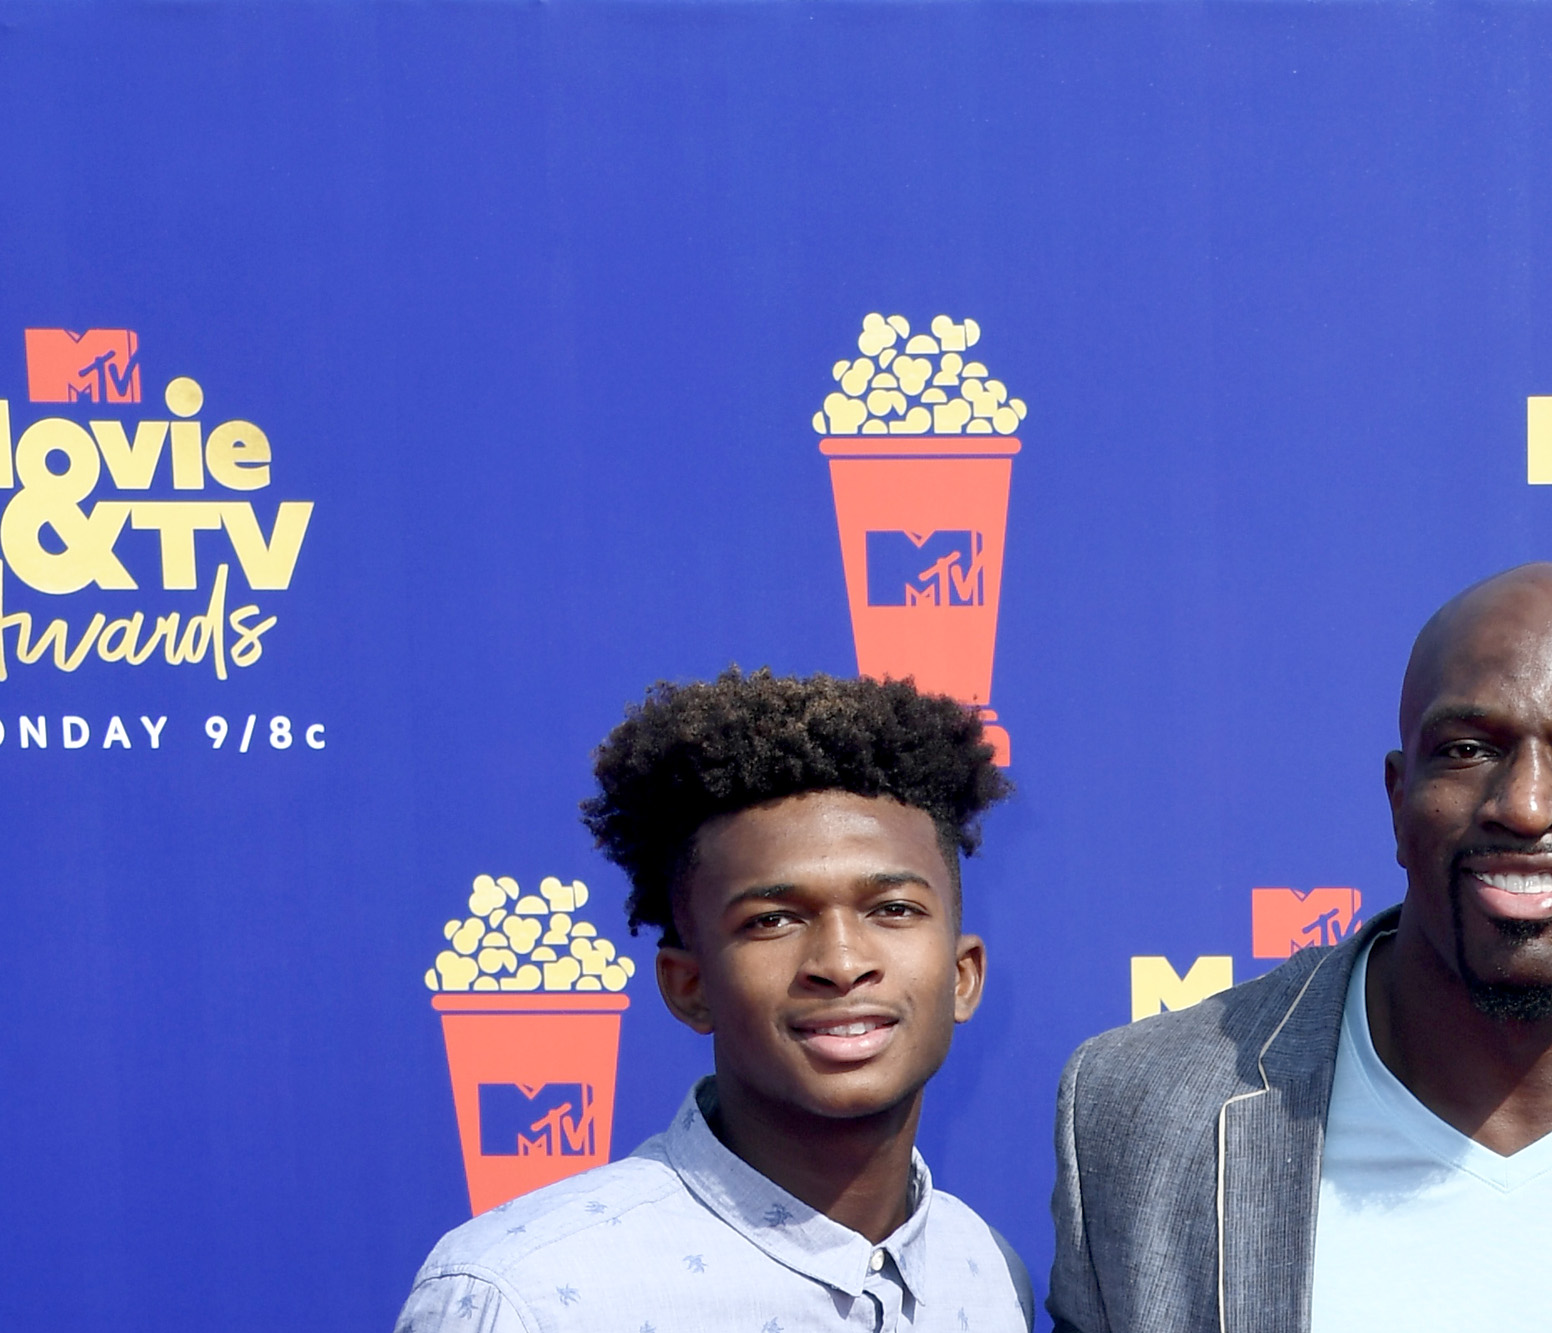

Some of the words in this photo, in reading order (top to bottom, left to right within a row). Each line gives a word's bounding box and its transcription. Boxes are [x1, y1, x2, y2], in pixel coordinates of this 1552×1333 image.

[24, 328, 141, 403] MTV
[0, 377, 272, 490] ovie
[866, 530, 984, 607] MTV
[0, 715, 168, 749] NDAY
[205, 714, 326, 753] 9/8c
[478, 1083, 595, 1156] MTV
